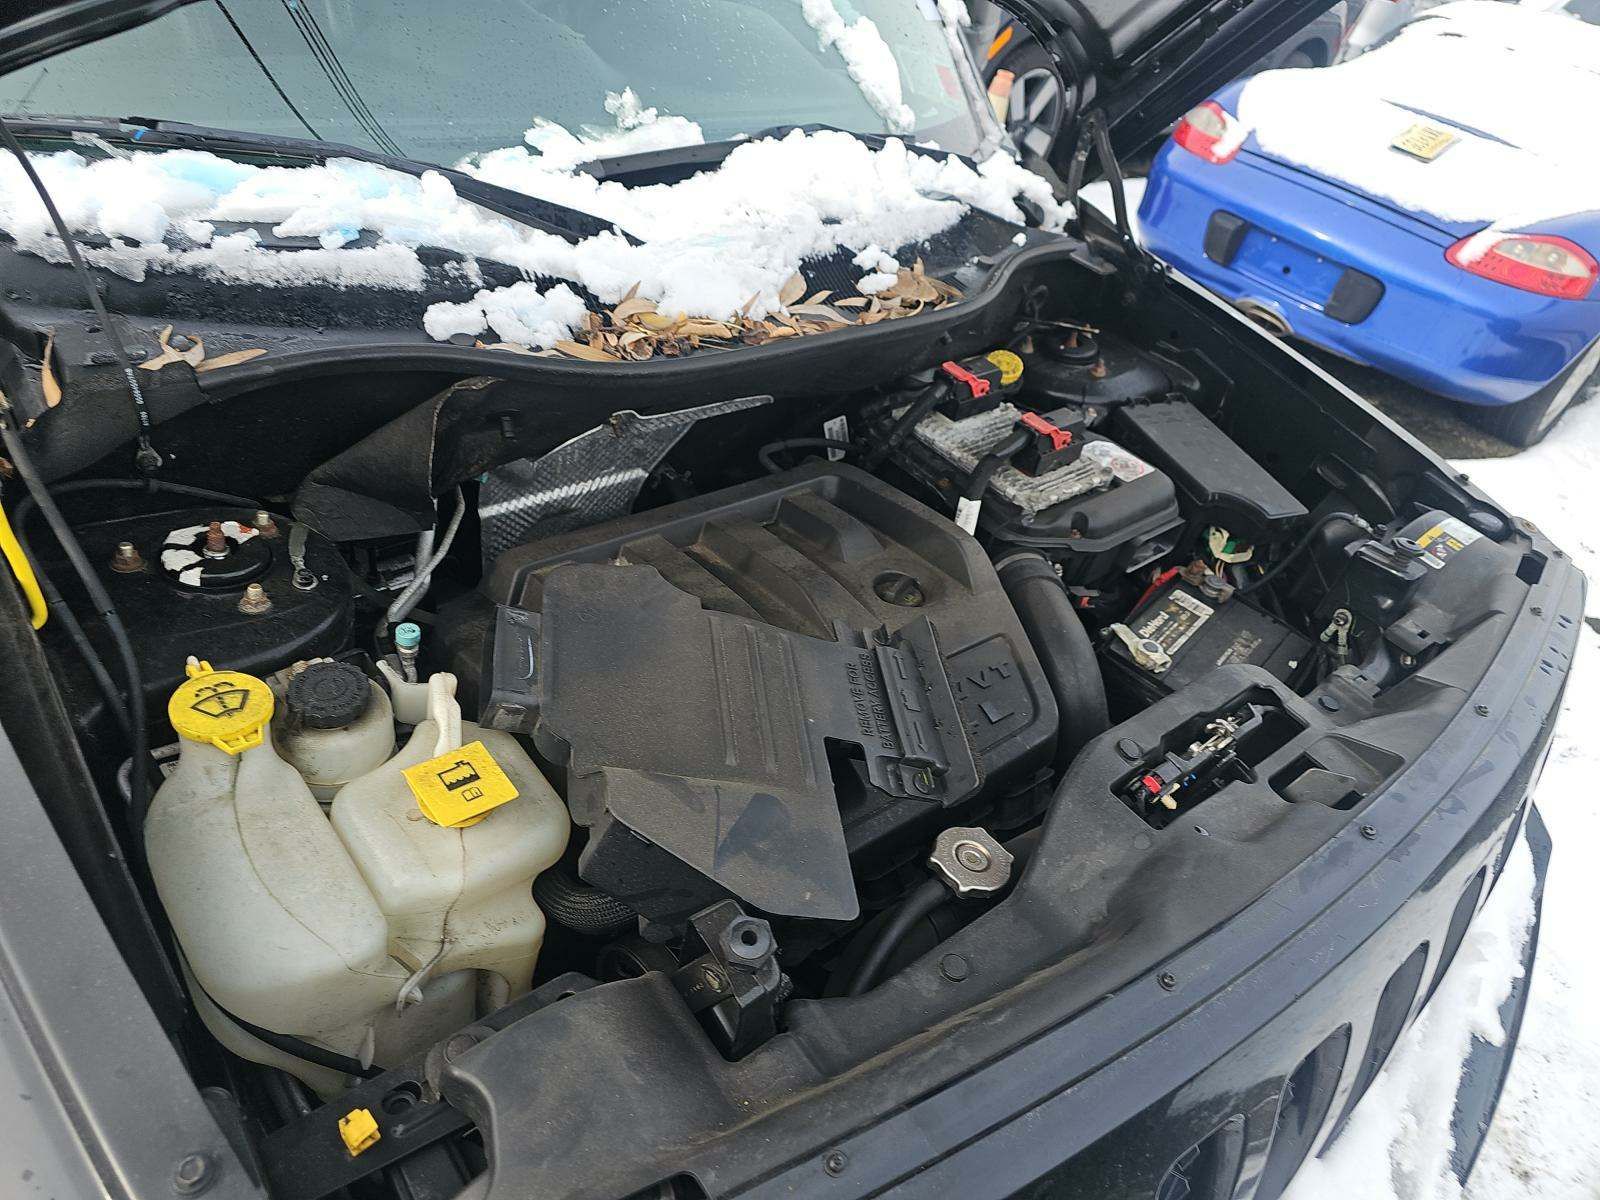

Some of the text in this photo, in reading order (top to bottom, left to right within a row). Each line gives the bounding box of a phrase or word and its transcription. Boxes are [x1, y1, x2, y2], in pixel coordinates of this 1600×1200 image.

[1138, 611, 1170, 638] DieHard
[846, 661, 875, 736] REMOVE FOR
[860, 651, 896, 749] BATTERY ACCESS
